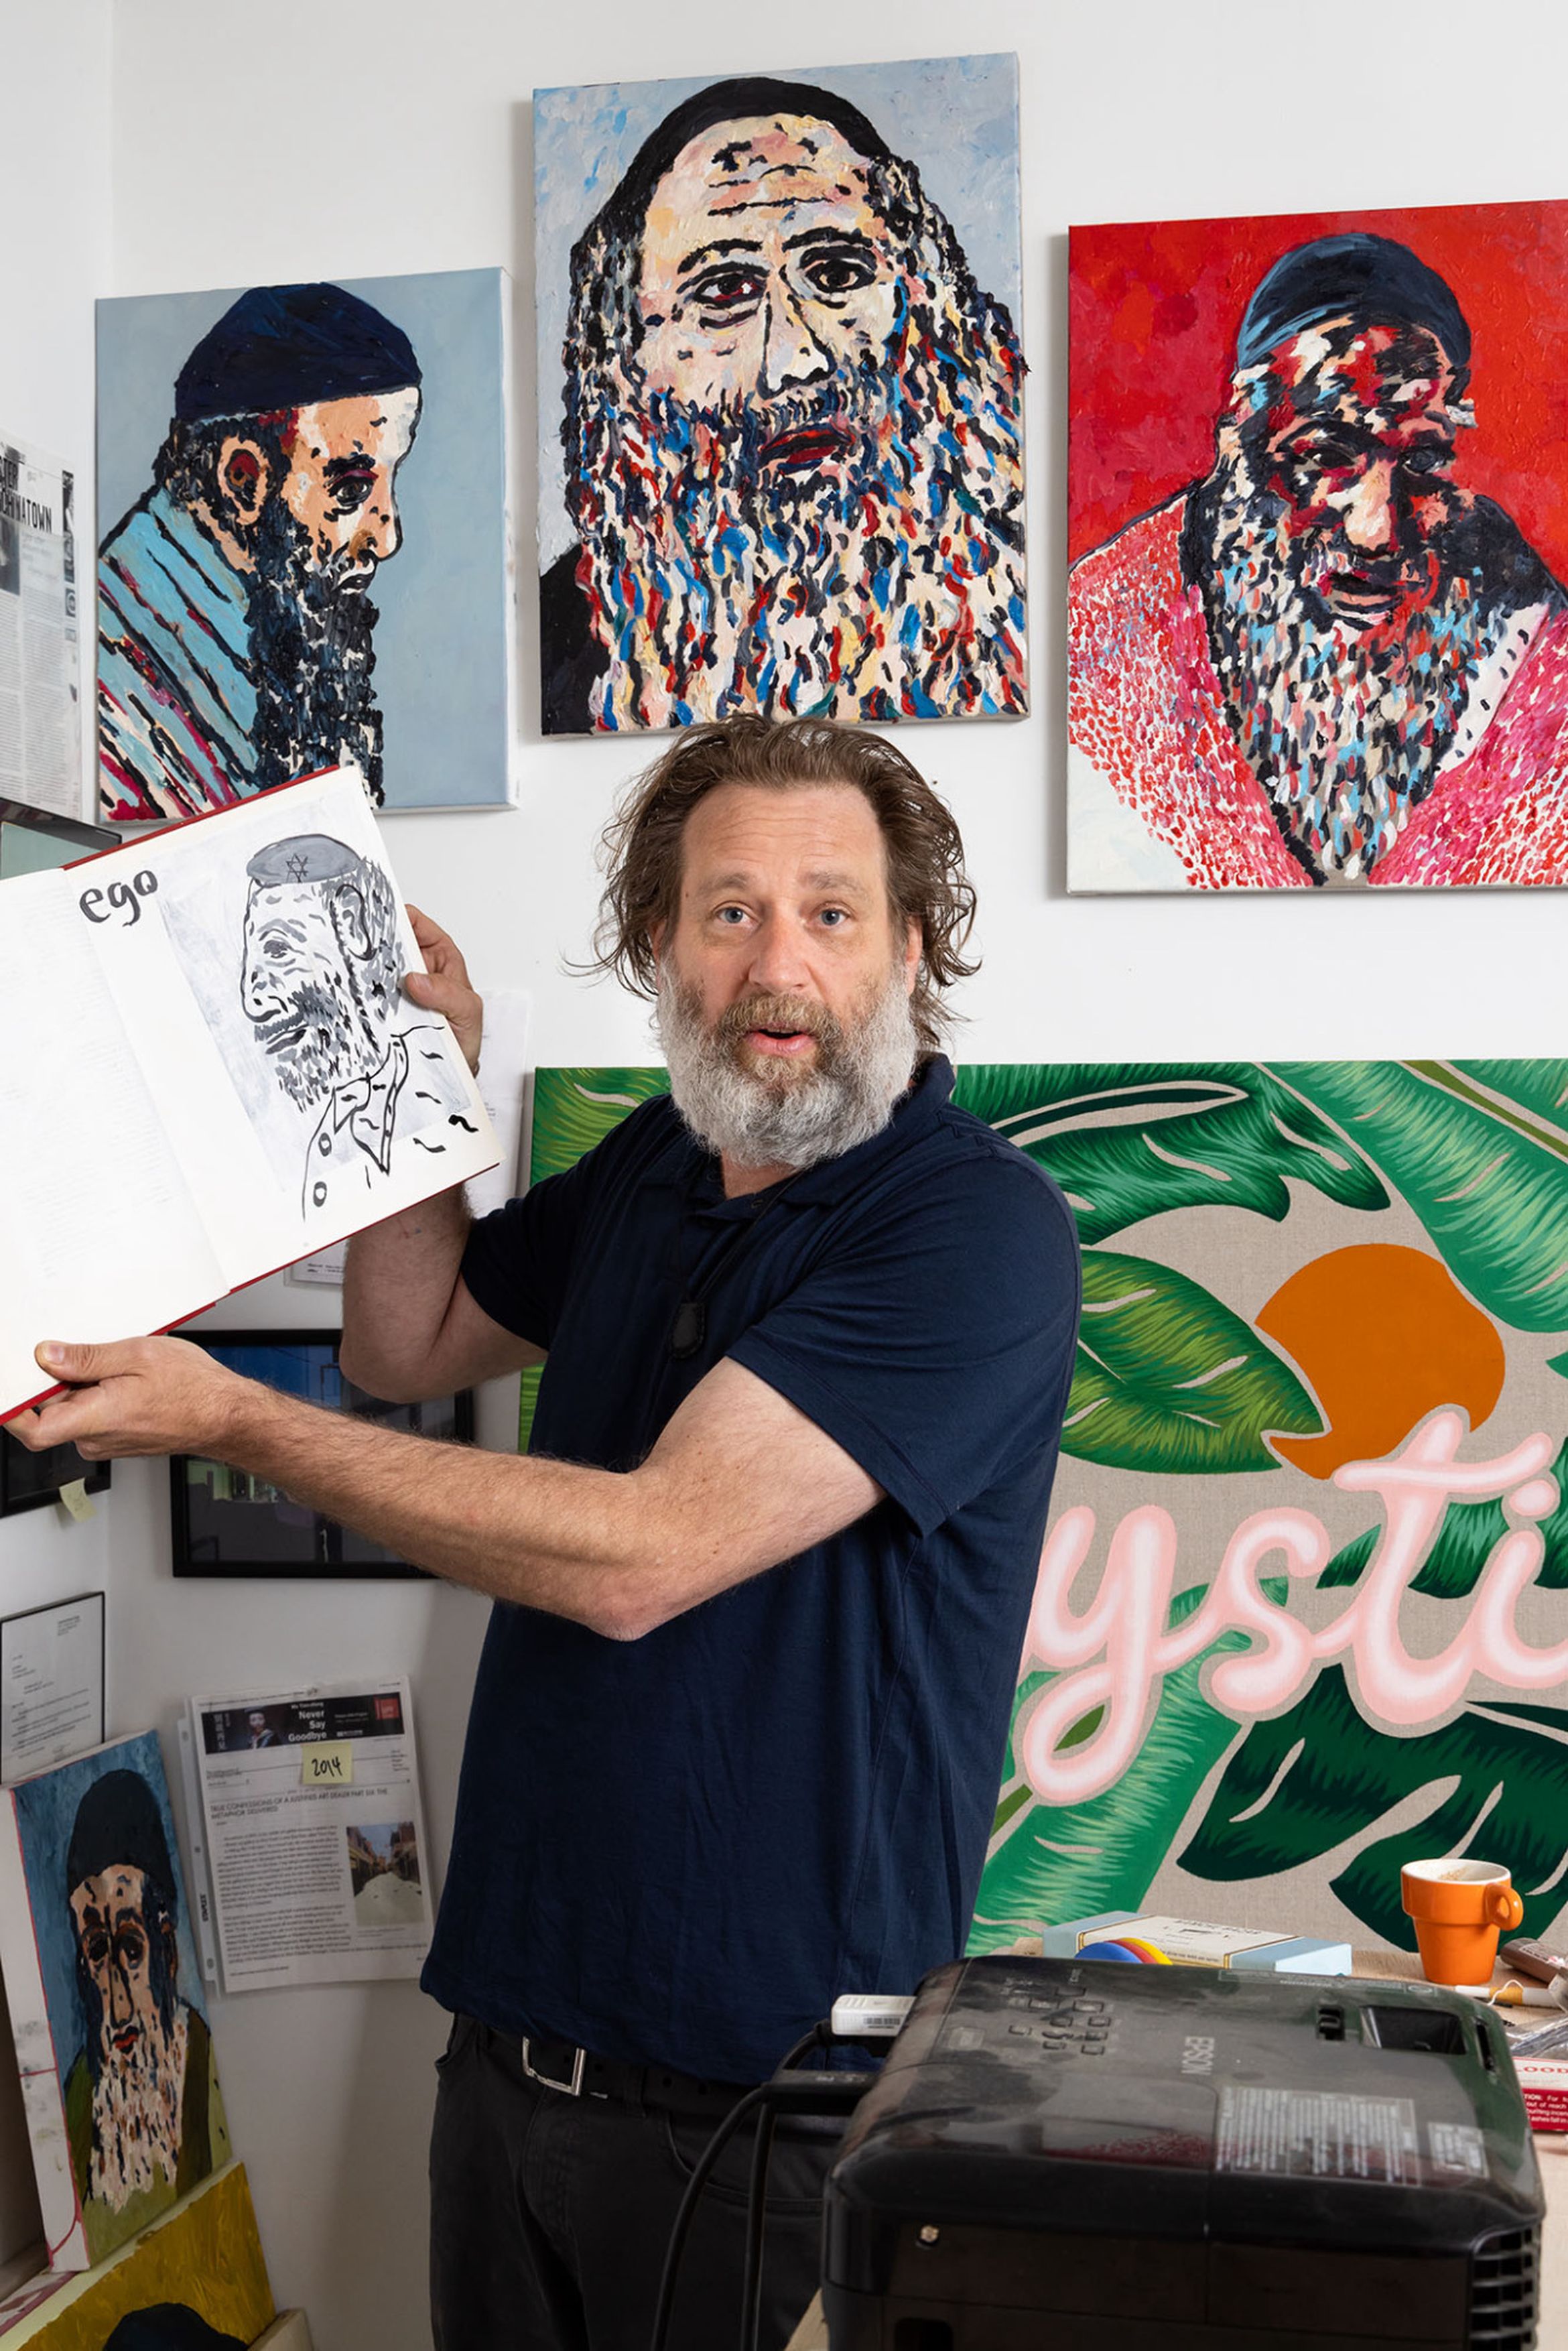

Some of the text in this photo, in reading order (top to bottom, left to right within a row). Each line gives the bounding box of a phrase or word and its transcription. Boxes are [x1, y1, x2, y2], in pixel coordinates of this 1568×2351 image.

[79, 870, 158, 928] ego
[298, 1710, 324, 1720] Never
[309, 1720, 326, 1730] Say
[288, 1731, 327, 1742] Goodbye
[312, 1757, 342, 1777] 2014
[1181, 2036, 1214, 2076] EPSON
